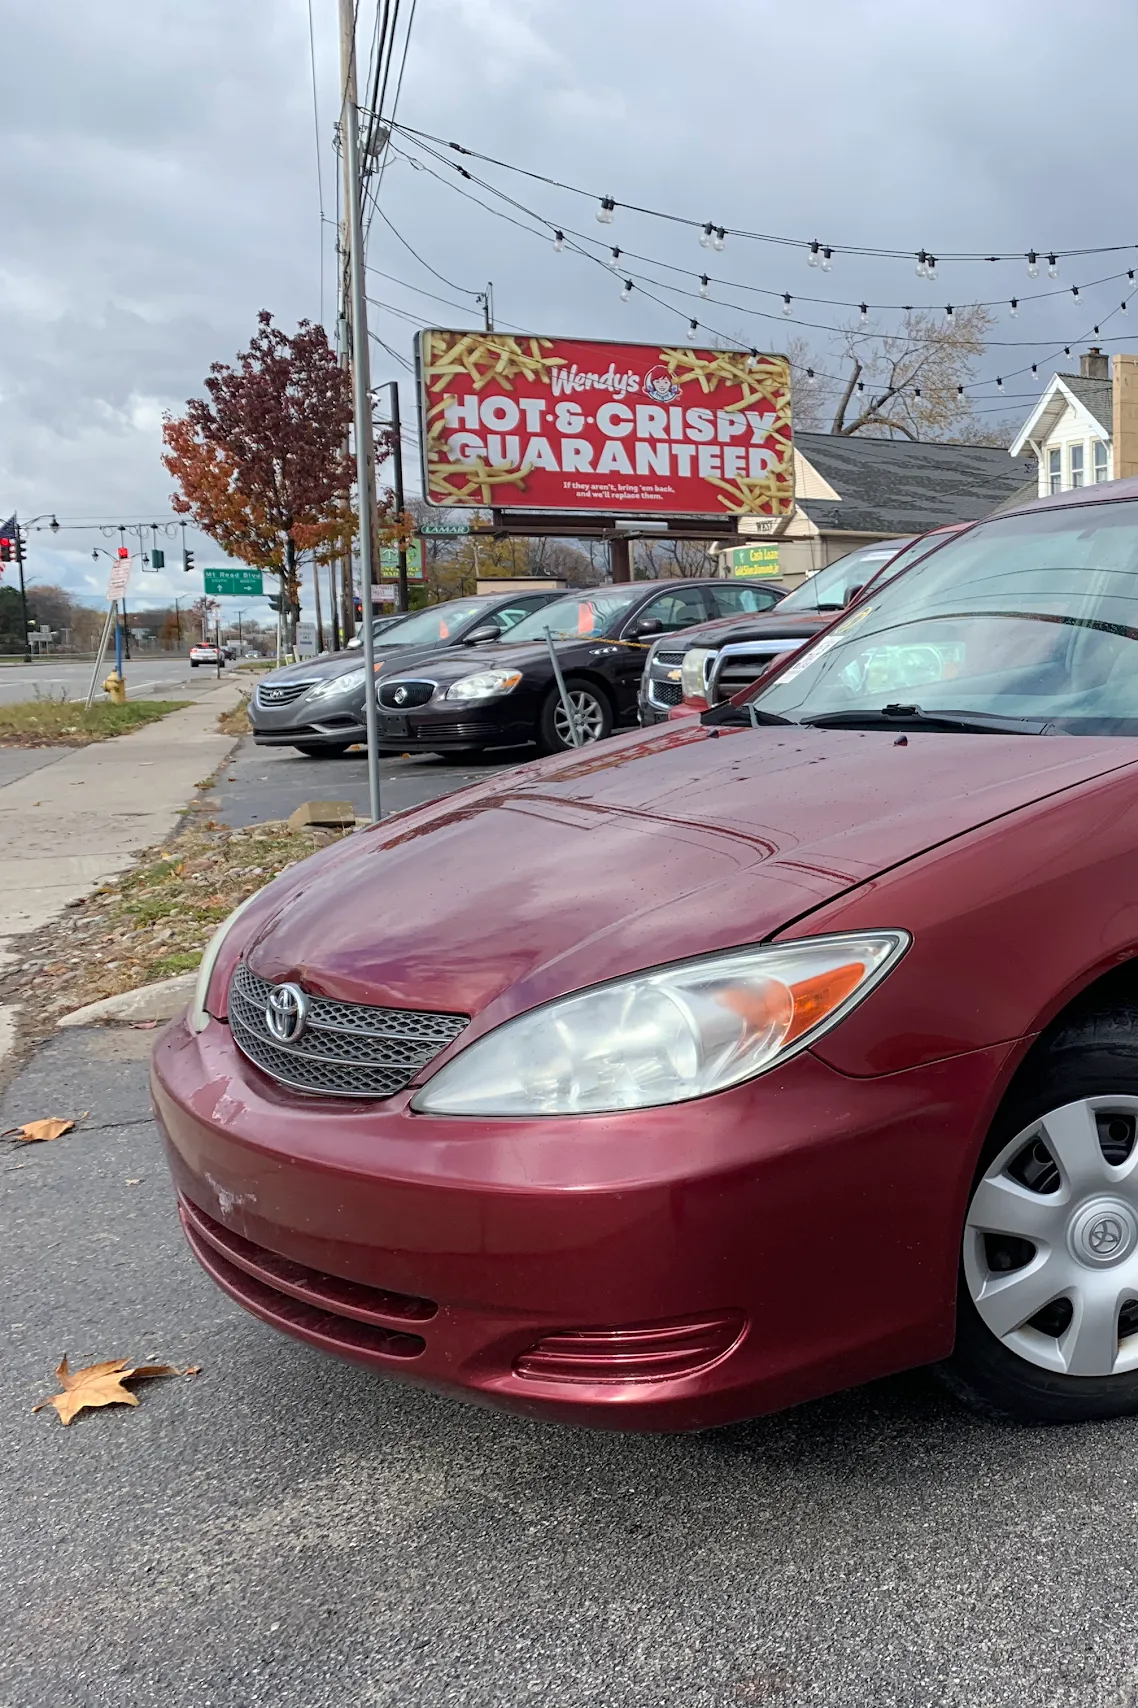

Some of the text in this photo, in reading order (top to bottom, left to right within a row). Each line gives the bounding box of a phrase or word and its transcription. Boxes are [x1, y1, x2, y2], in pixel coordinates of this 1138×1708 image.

[550, 362, 640, 400] Wendy's
[443, 392, 547, 434] HOT
[595, 401, 777, 445] CRISPY
[446, 431, 779, 479] GUARANTEED
[563, 481, 571, 489] If
[571, 482, 590, 491] they
[590, 483, 617, 491] aren't,
[617, 483, 639, 493] bring
[654, 484, 676, 493] back,
[576, 490, 591, 498] and
[611, 492, 640, 500] replace
[640, 492, 664, 500] them.
[425, 525, 465, 533] LAMAR
[750, 548, 763, 561] Cash
